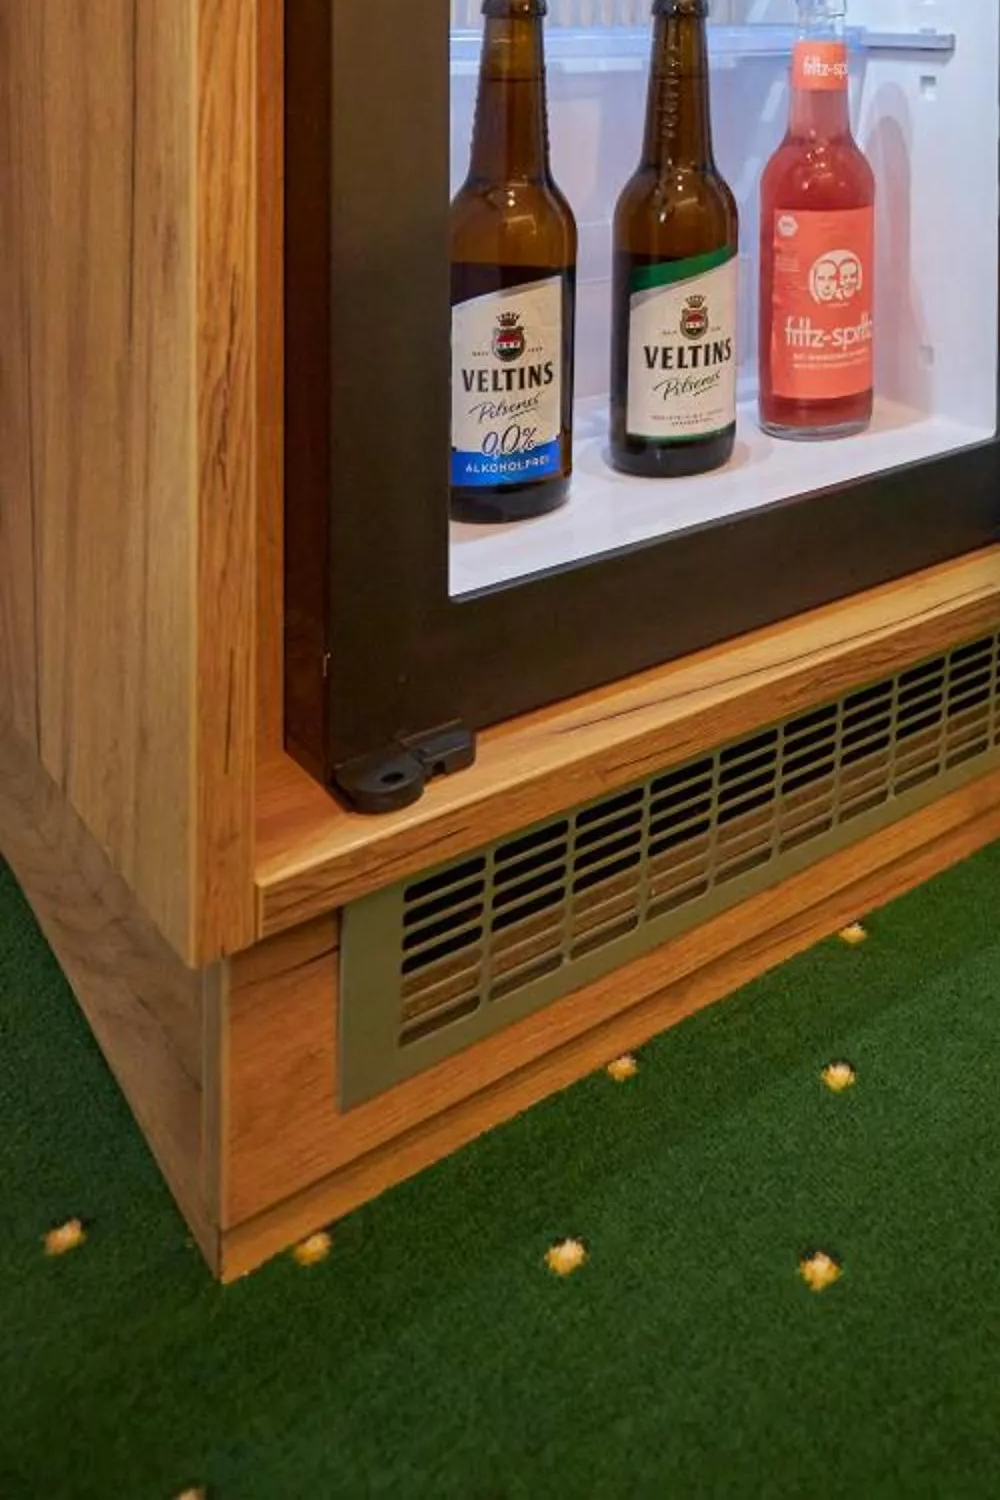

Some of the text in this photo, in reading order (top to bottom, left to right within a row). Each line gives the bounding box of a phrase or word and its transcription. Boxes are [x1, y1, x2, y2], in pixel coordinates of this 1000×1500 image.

[643, 337, 732, 370] VELTINS
[461, 360, 554, 392] VELTINS
[465, 454, 550, 474] ALKOHOLFREI
